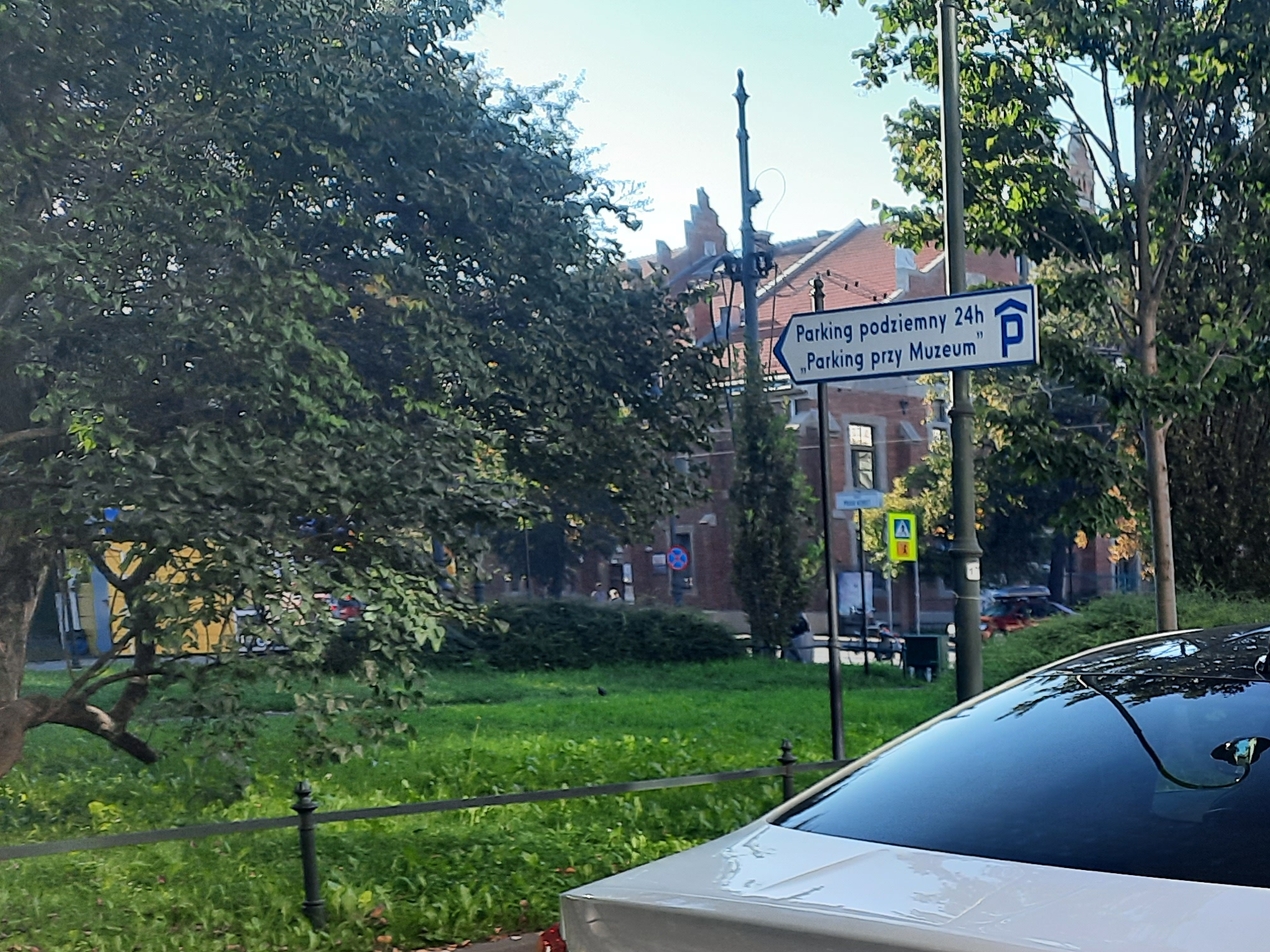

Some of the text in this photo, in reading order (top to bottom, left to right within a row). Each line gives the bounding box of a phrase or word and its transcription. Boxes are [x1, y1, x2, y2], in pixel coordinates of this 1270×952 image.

[796, 304, 985, 343] Parking podziemny 24h
[871, 348, 902, 370] przy
